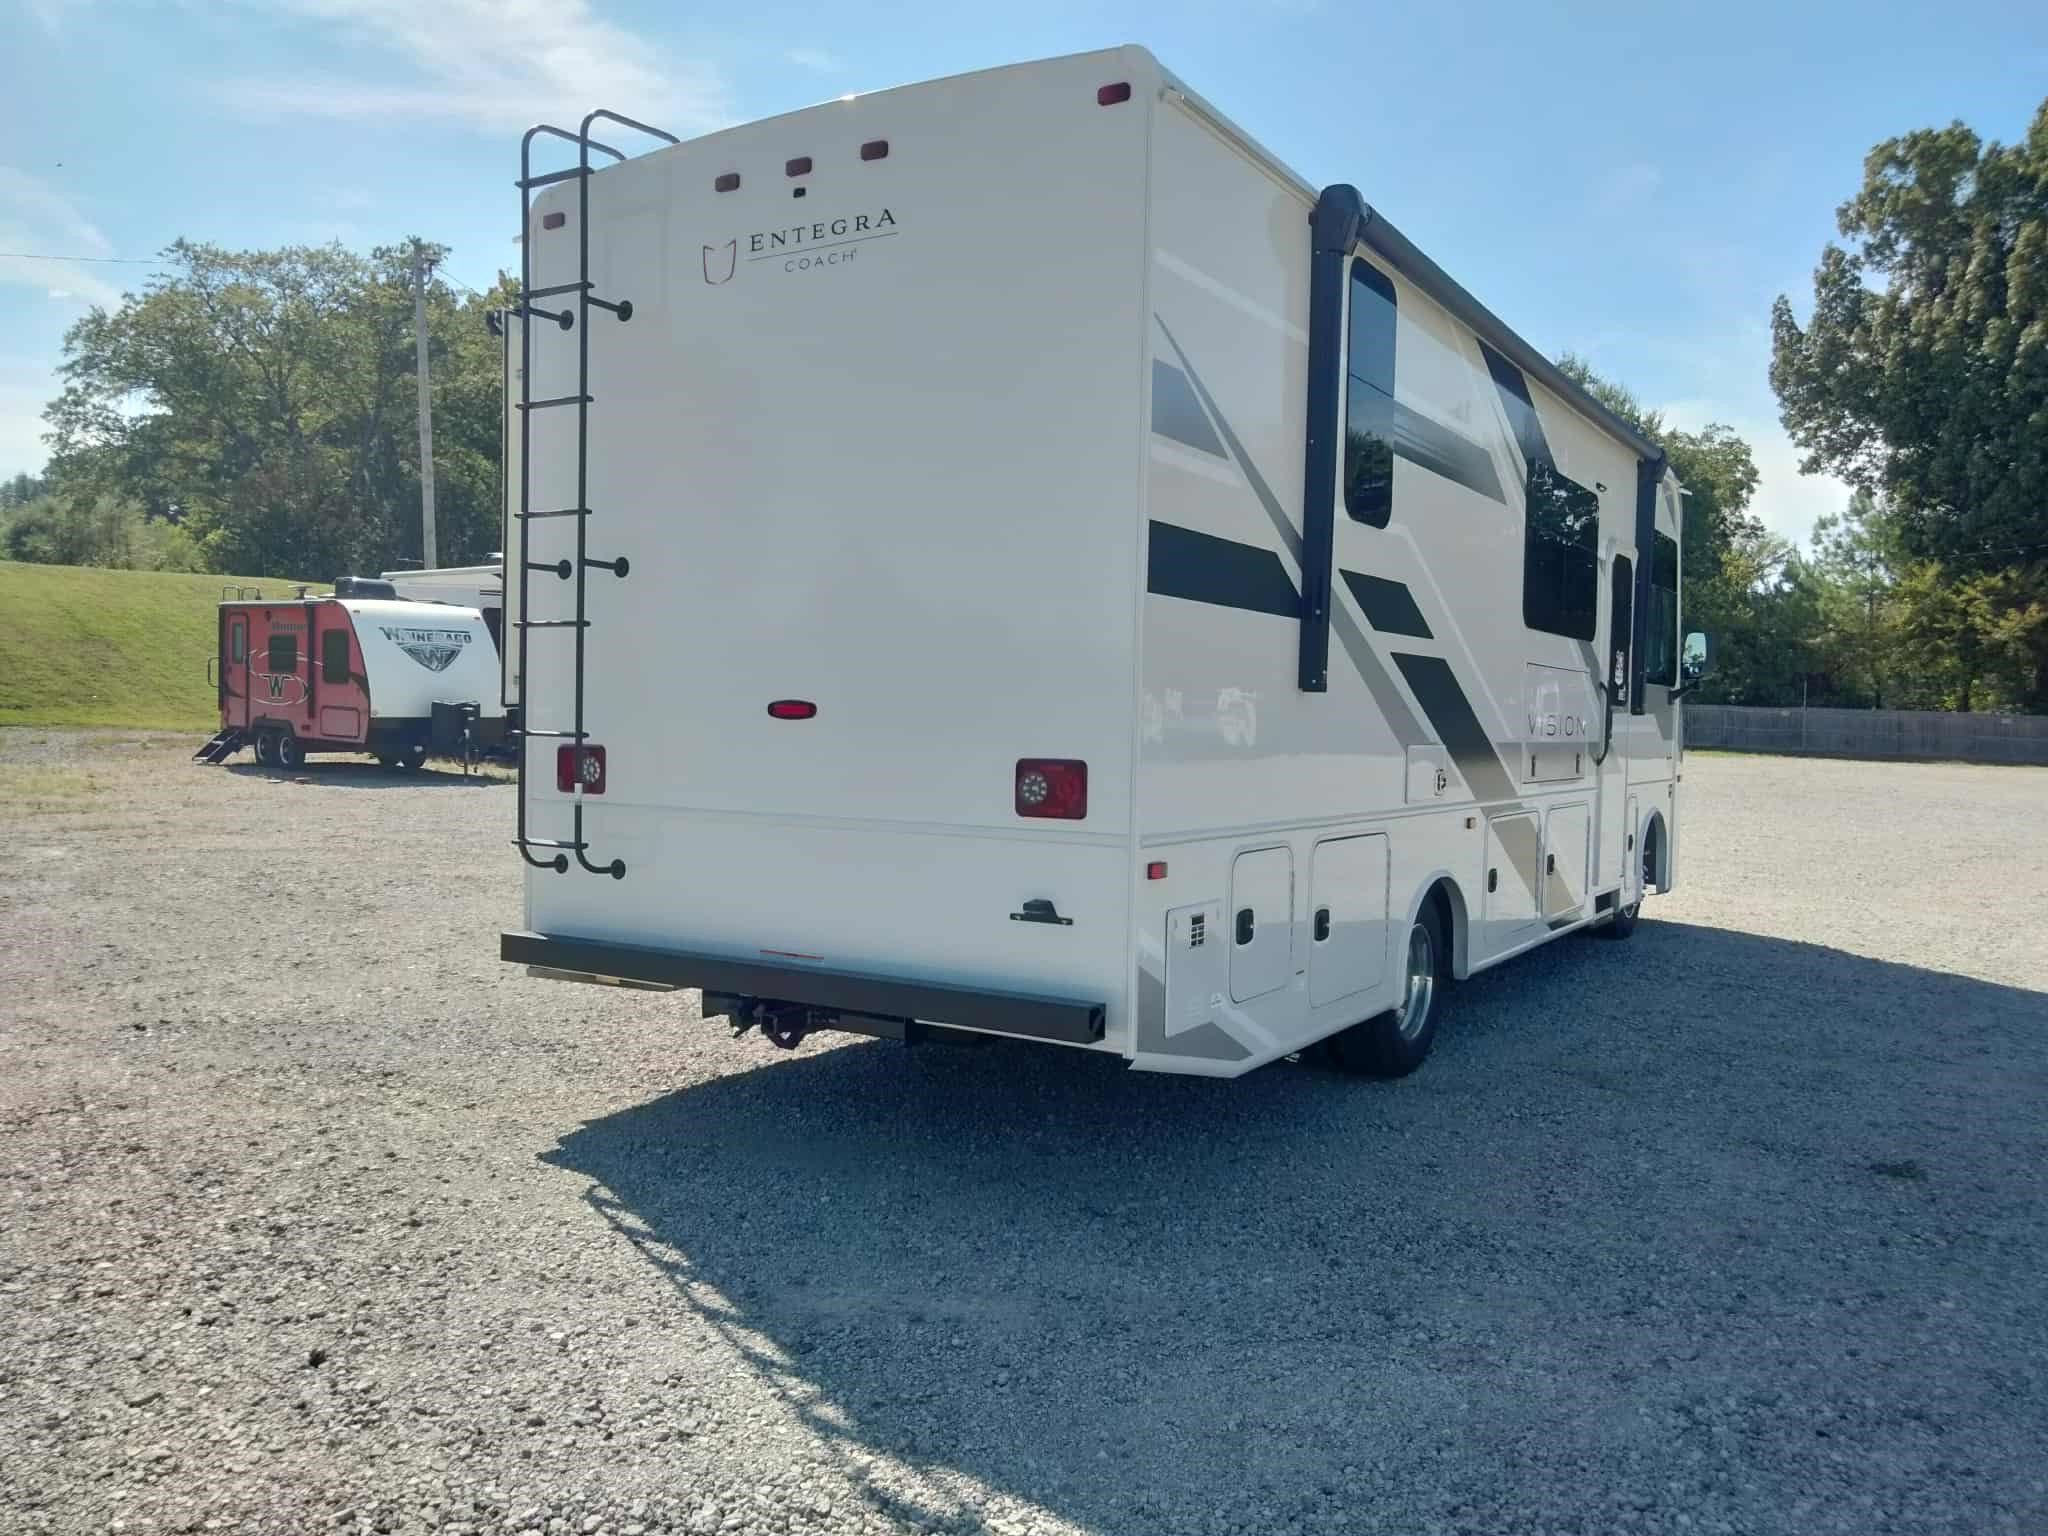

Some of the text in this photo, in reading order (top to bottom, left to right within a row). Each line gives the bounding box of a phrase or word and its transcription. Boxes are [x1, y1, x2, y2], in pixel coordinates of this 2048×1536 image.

[750, 208, 897, 252] ENTEGRA
[784, 251, 856, 273] COACH
[1527, 713, 1585, 737] VISION
